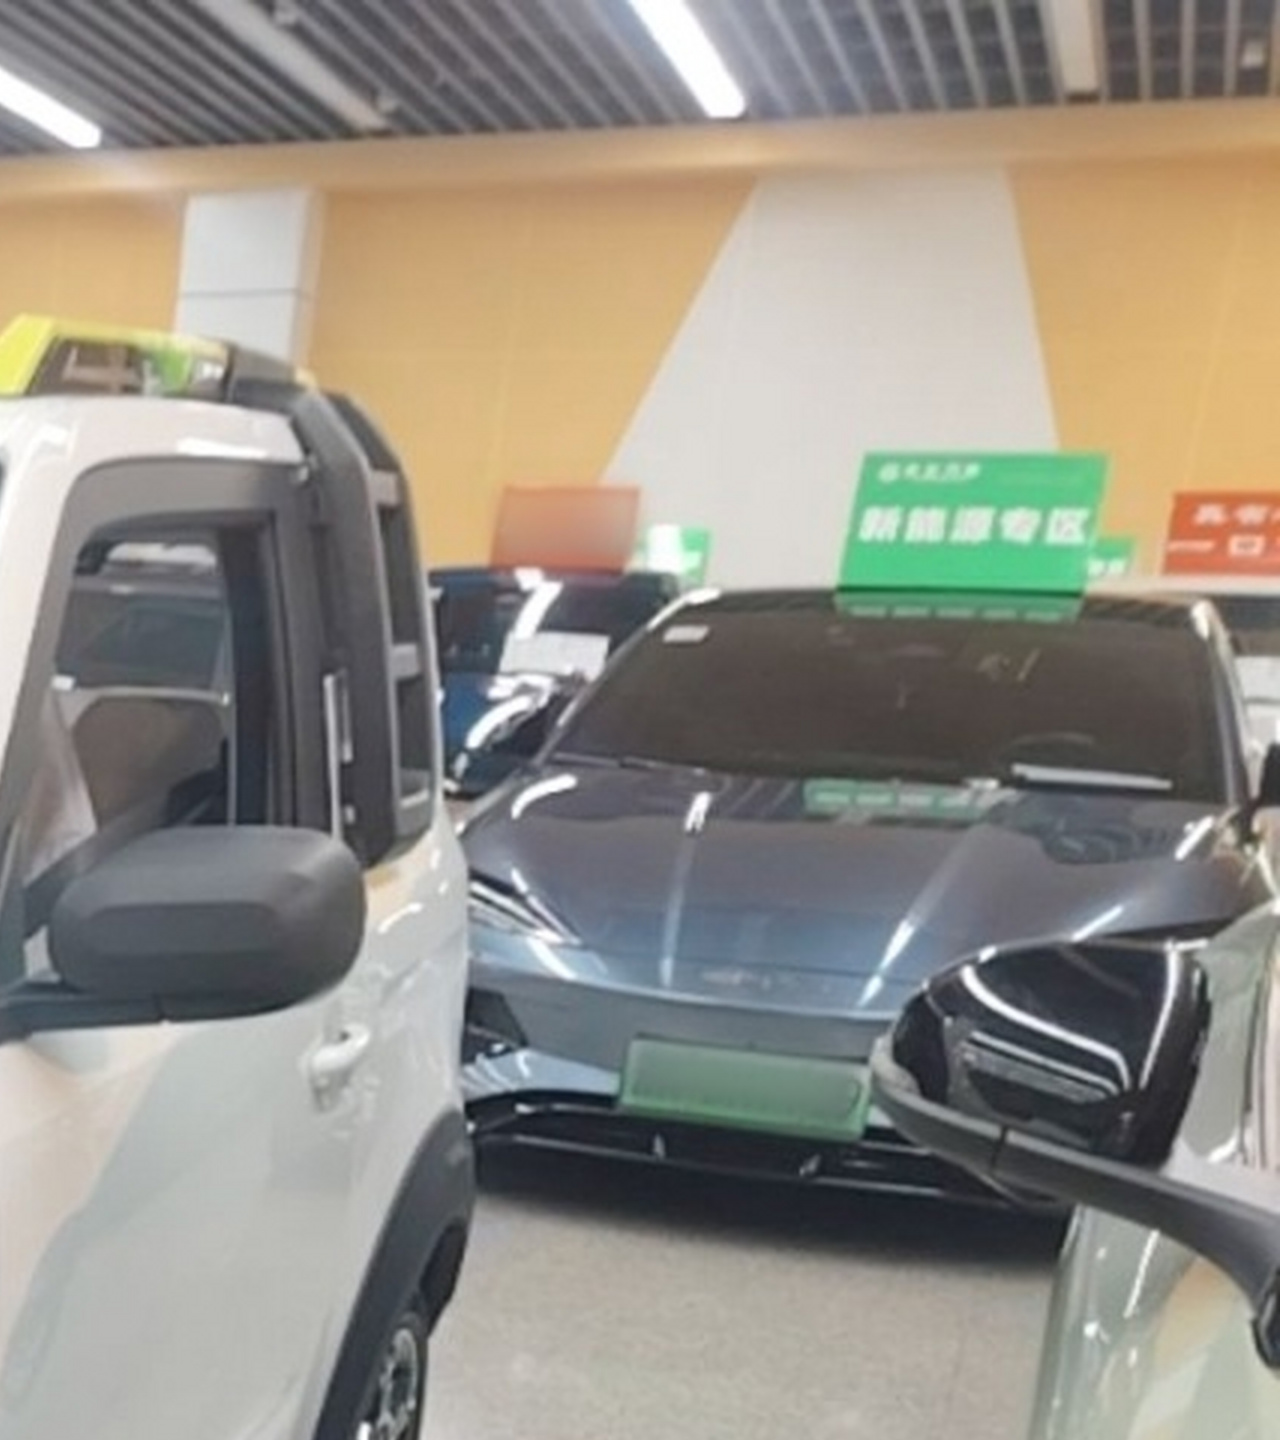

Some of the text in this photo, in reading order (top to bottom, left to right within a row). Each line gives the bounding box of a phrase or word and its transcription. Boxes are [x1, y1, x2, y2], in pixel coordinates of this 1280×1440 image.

[859, 507, 1090, 545] 新能源专区
